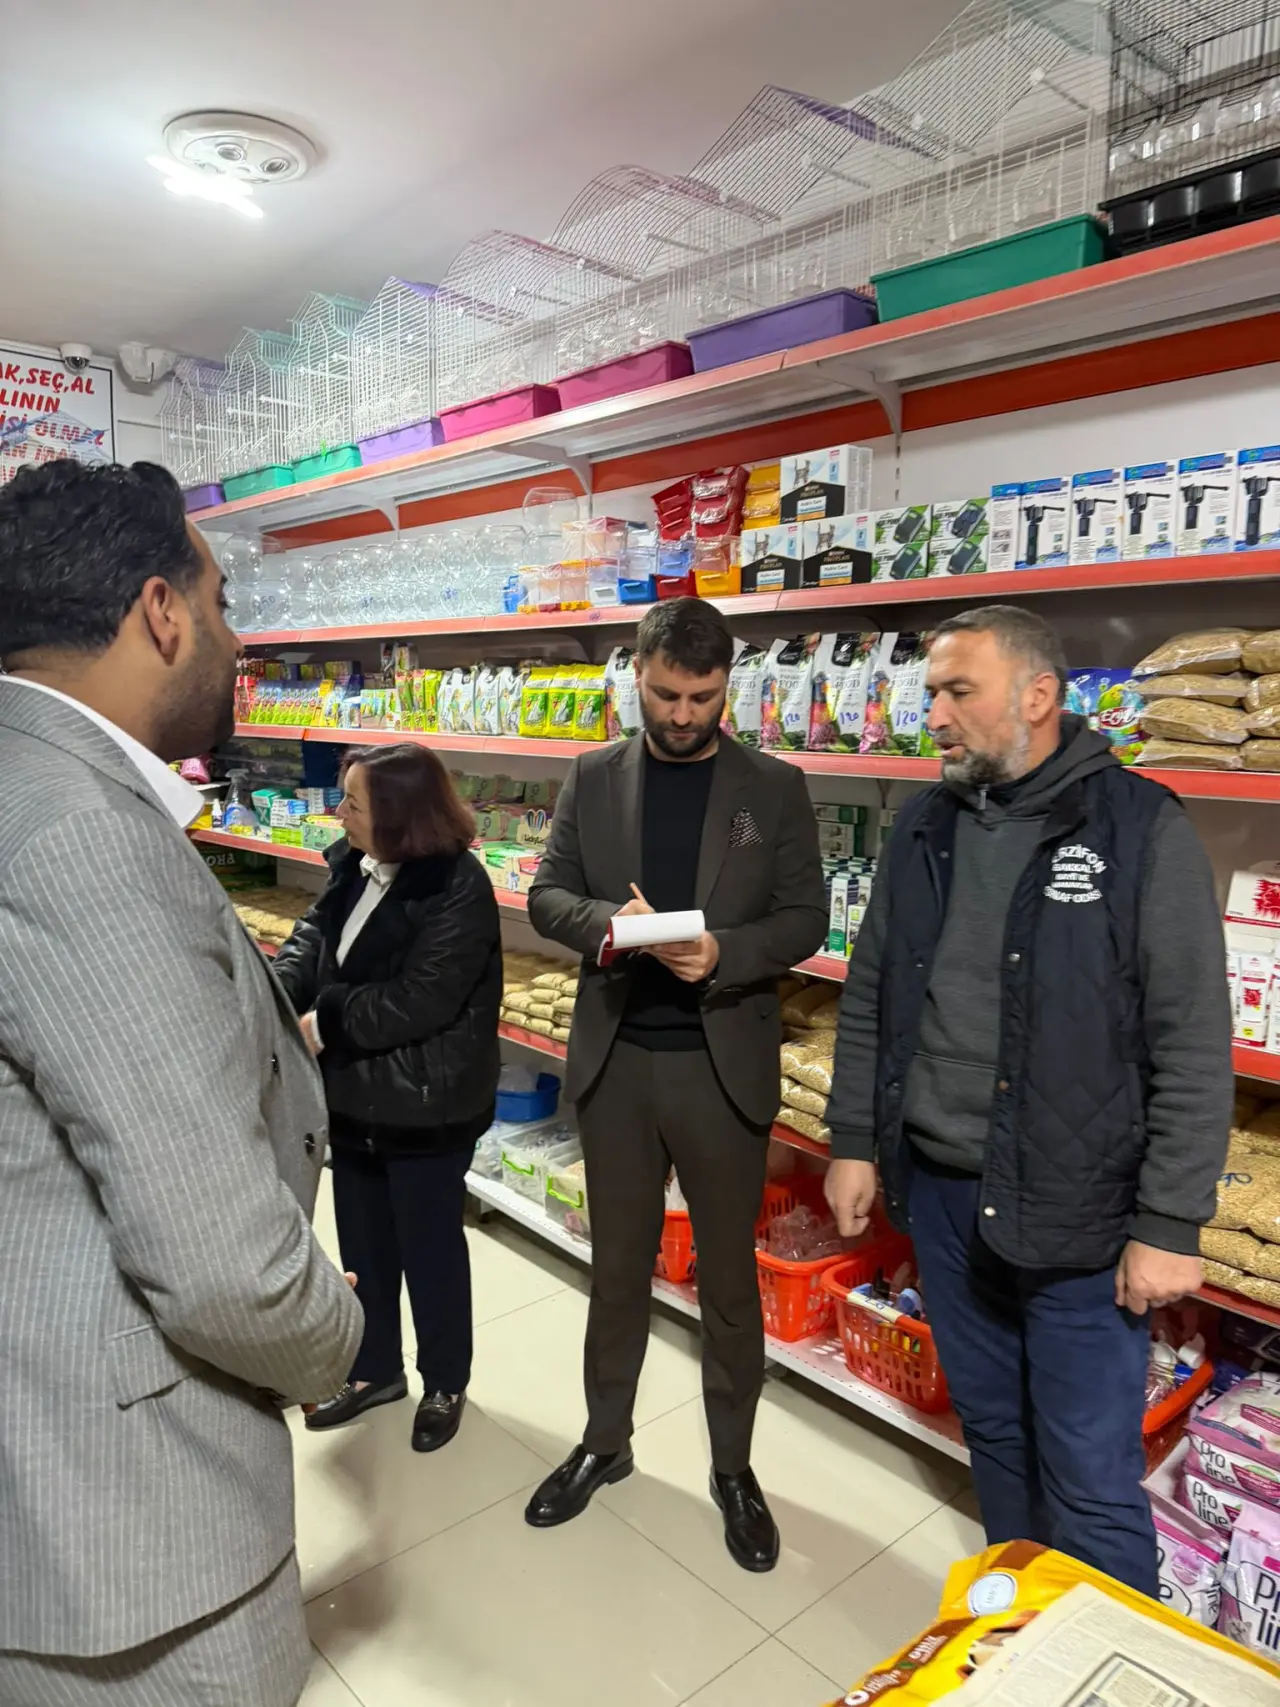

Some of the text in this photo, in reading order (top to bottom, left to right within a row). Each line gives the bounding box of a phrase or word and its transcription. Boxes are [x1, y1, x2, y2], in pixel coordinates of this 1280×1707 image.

[1200, 1441, 1226, 1469] Pro
[1193, 1481, 1218, 1510] Pro
[1198, 1500, 1229, 1528] line
